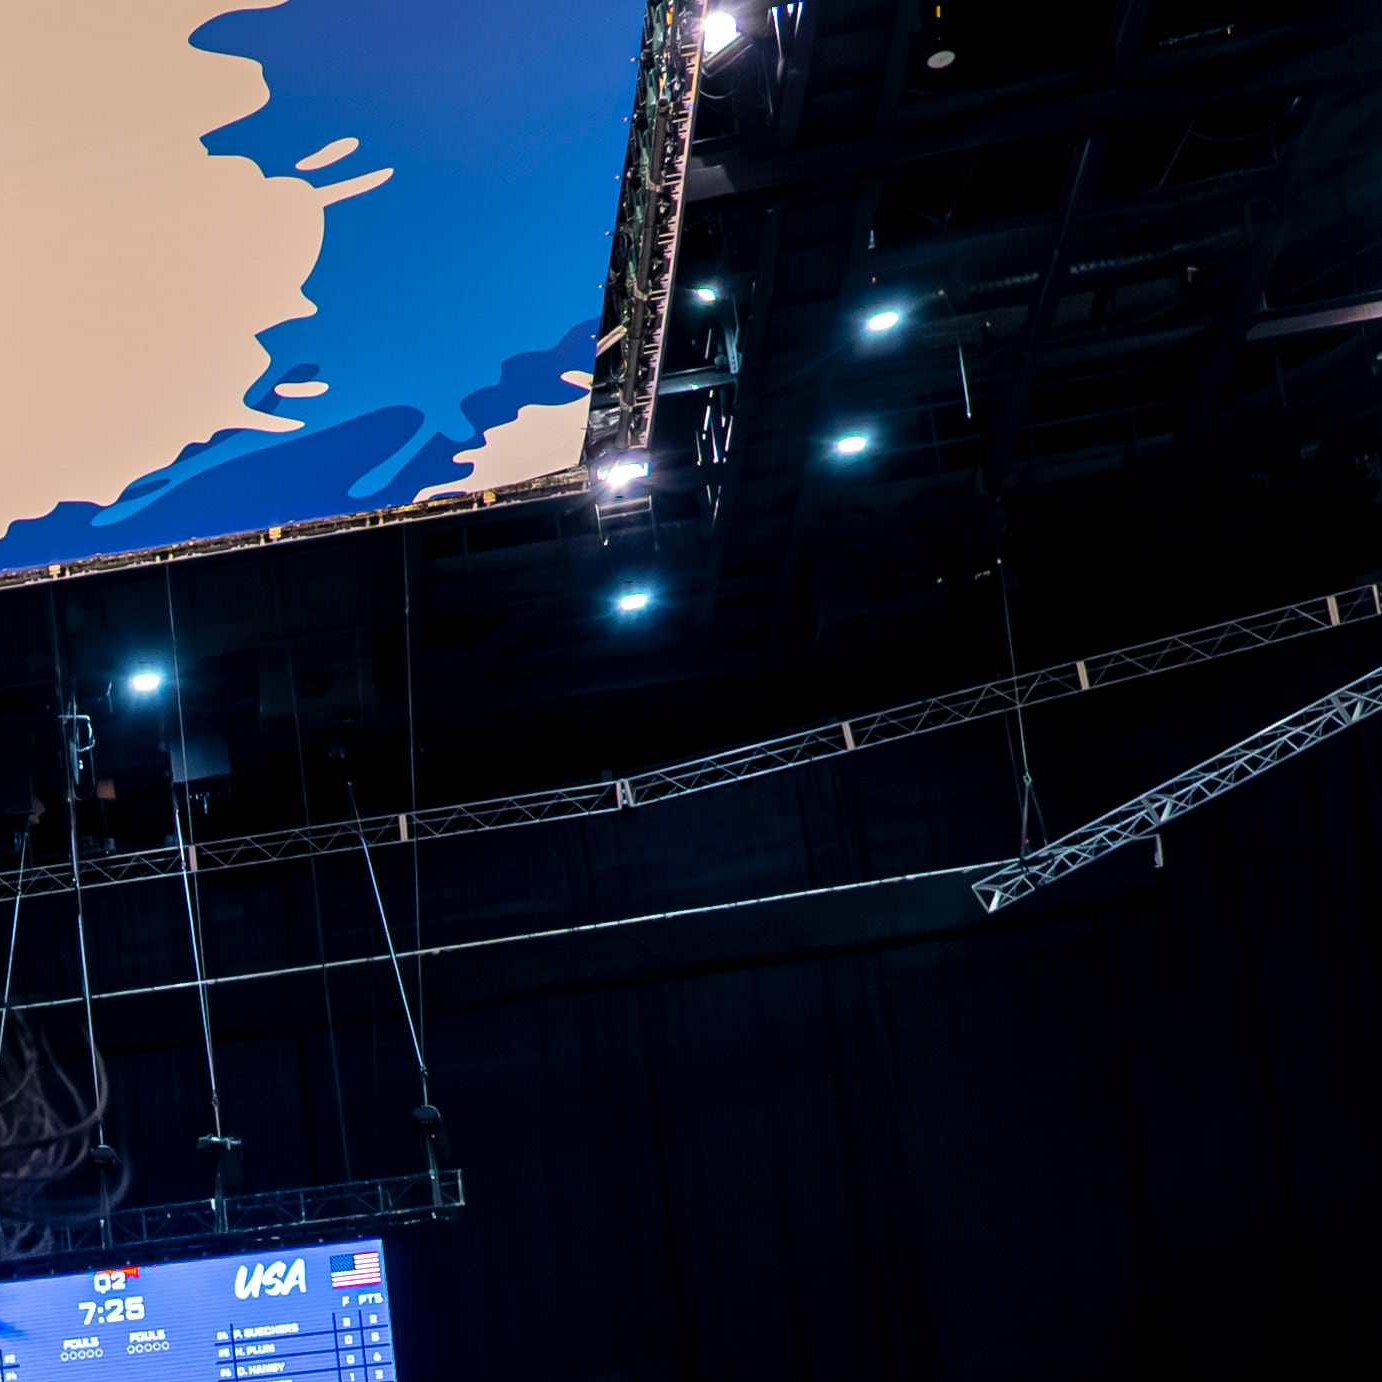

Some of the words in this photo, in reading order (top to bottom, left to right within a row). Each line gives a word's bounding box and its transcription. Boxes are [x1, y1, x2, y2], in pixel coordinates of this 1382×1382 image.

[93, 1271, 126, 1294] Q2
[234, 1258, 307, 1300] USA
[357, 1292, 384, 1306] PTS
[77, 1295, 145, 1325] 7:25
[62, 1336, 101, 1350] FOULS
[129, 1329, 166, 1343] FOULS
[246, 1343, 276, 1356] PLUM
